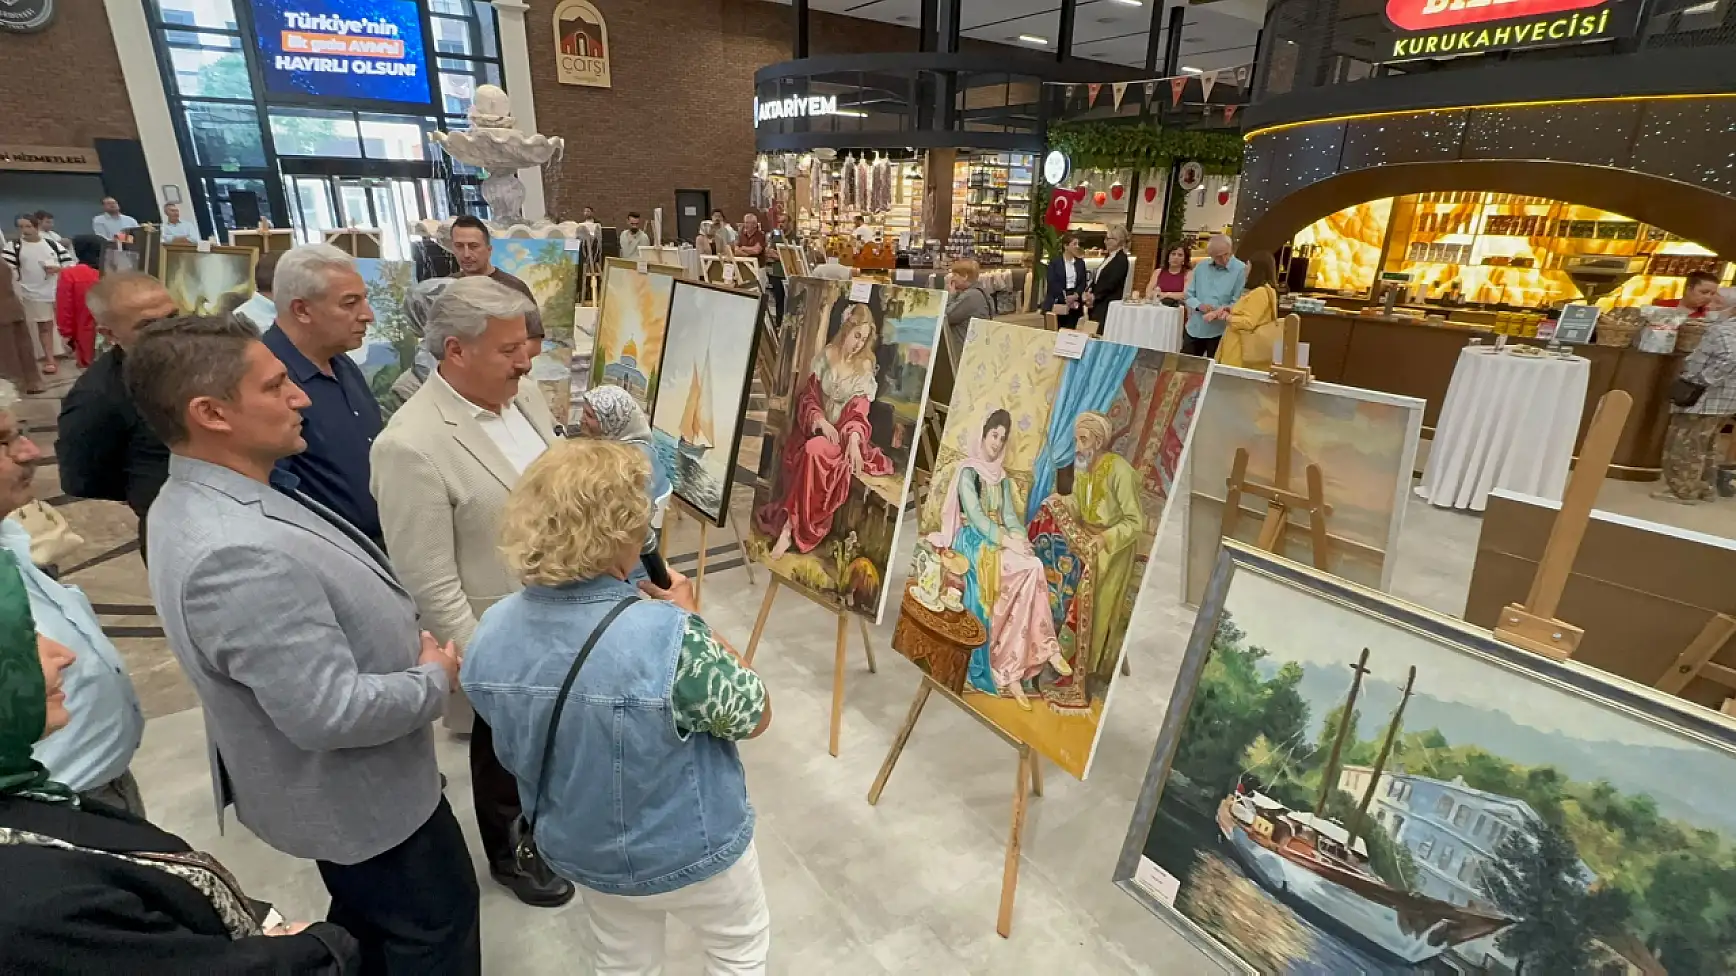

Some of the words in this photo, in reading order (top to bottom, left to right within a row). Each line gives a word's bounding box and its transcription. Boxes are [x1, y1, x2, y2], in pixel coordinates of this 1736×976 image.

[284, 11, 398, 35] Türkiye'nin
[1392, 9, 1611, 57] KURUKAHVECİSİ
[275, 55, 348, 73] HAYIRLI
[352, 60, 416, 77] OLSUN!
[759, 93, 837, 121] AKTARİYEM
